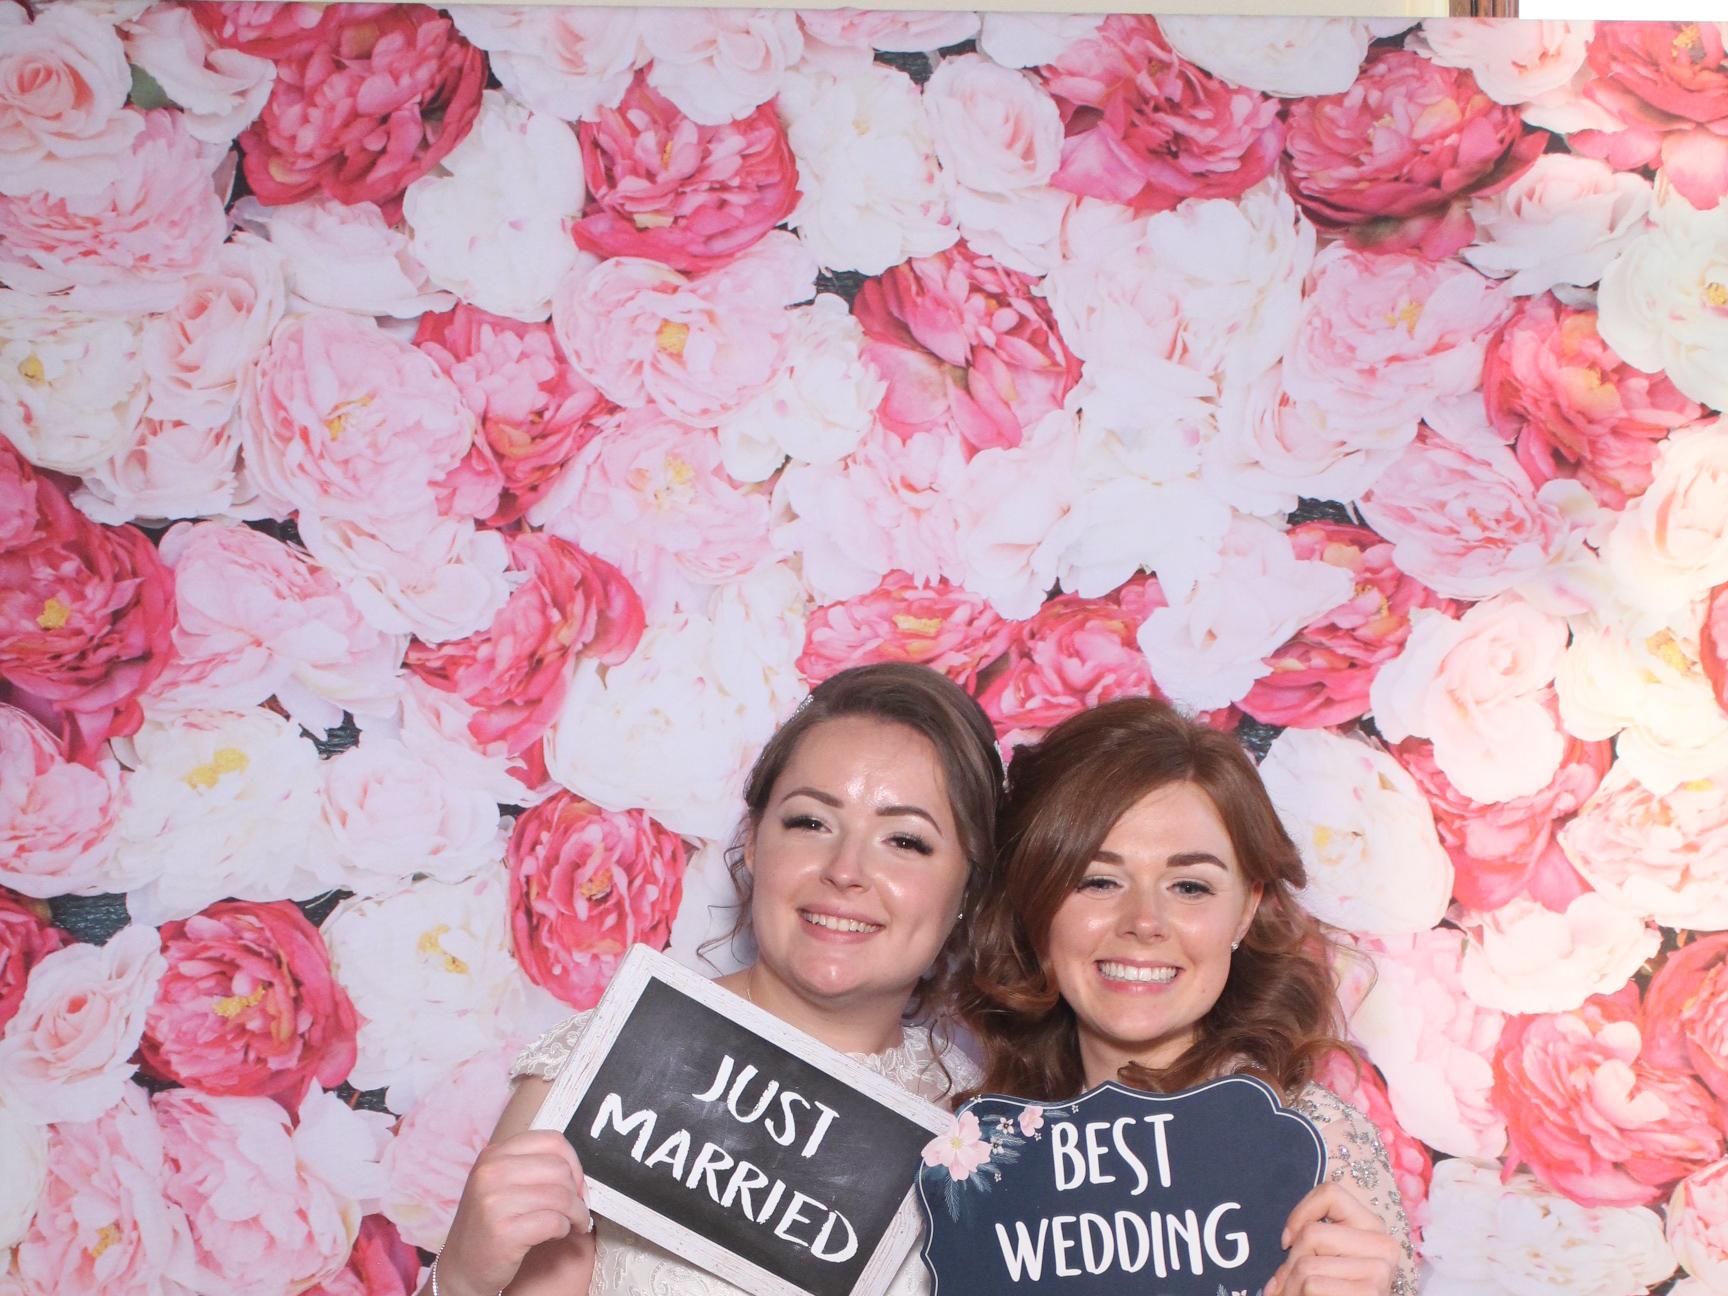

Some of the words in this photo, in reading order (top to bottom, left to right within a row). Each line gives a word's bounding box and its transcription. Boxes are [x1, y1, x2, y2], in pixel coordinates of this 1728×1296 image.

[691, 1054, 840, 1159] JUST
[590, 1092, 859, 1263] MARRIED
[1051, 1113, 1175, 1196] BEST
[995, 1201, 1250, 1282] WEDDING
